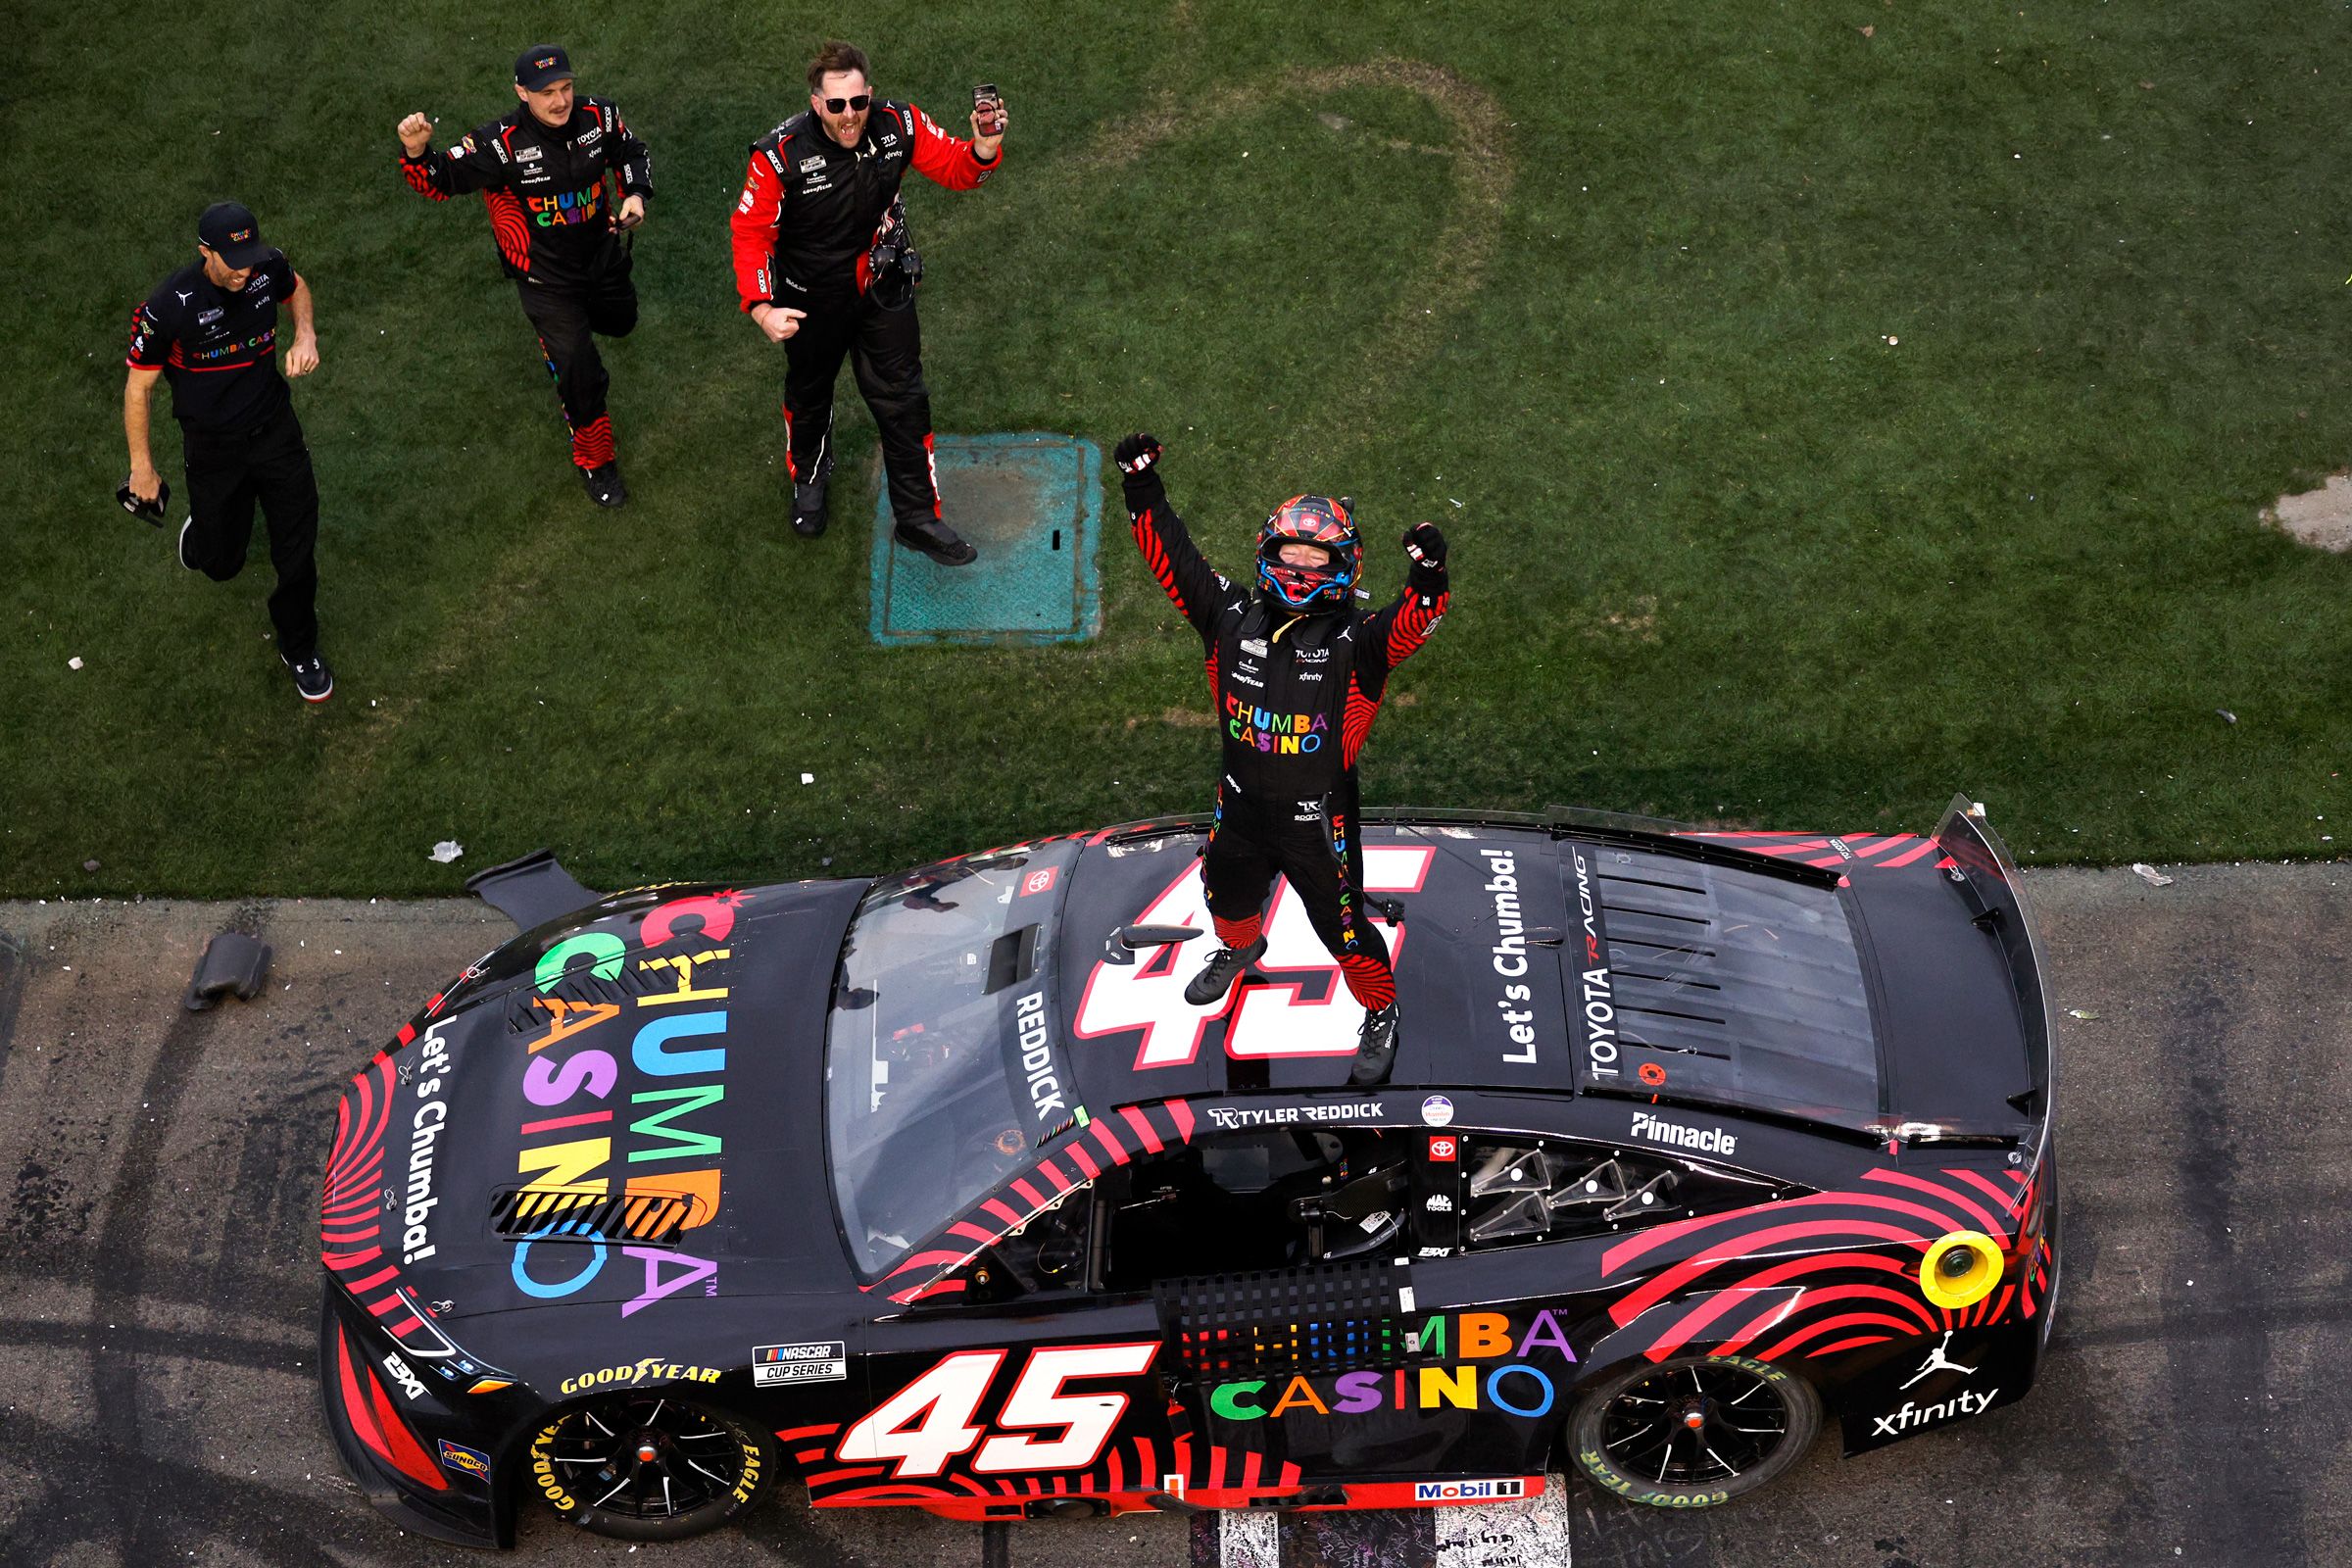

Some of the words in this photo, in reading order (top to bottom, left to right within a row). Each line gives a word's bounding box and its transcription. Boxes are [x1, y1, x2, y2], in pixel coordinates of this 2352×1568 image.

[491, 138, 509, 165] sparco
[576, 125, 603, 145] TOYOTA
[765, 149, 784, 174] sparco
[526, 181, 602, 211] CHUMB
[802, 183, 833, 195] GOODYEAR
[246, 273, 270, 293] OYOTA
[1231, 671, 1264, 688] OODYEAR
[1298, 672, 1323, 682] xfinity
[1226, 691, 1329, 733] CHUMBA
[1229, 719, 1321, 755] CASINO
[1480, 849, 1529, 978] Chumba!
[1572, 846, 1600, 967] RACING
[1073, 846, 1437, 1071] 45
[1497, 984, 1538, 1064] Let's
[1582, 967, 1619, 1081] TOYOTA
[416, 1014, 458, 1099] Let's
[1016, 991, 1065, 1121] REDDICK
[512, 932, 626, 1298] CASINO
[622, 889, 745, 1319] CHUMBA
[1238, 1107, 1299, 1125] TYLER
[1299, 1102, 1384, 1121] REDDICK
[1631, 1111, 1738, 1155] Pinnacle
[403, 1101, 448, 1265] Chumba!
[1426, 1194, 1452, 1206] MAC
[766, 1366, 791, 1379] CUP
[792, 1363, 833, 1376] SERIES
[782, 1346, 831, 1360] NASCAR
[1707, 1356, 1788, 1382] EAGLE
[561, 1357, 722, 1396] GOODYEAR
[1210, 1364, 1555, 1421] CASINO
[834, 1341, 1163, 1479] 45
[1872, 1388, 2000, 1438] xfinity
[443, 1451, 488, 1472] SUNOCO
[530, 1414, 576, 1511] GOODYE
[732, 1444, 761, 1504] EAGLE
[1418, 1482, 1491, 1498] Mobil
